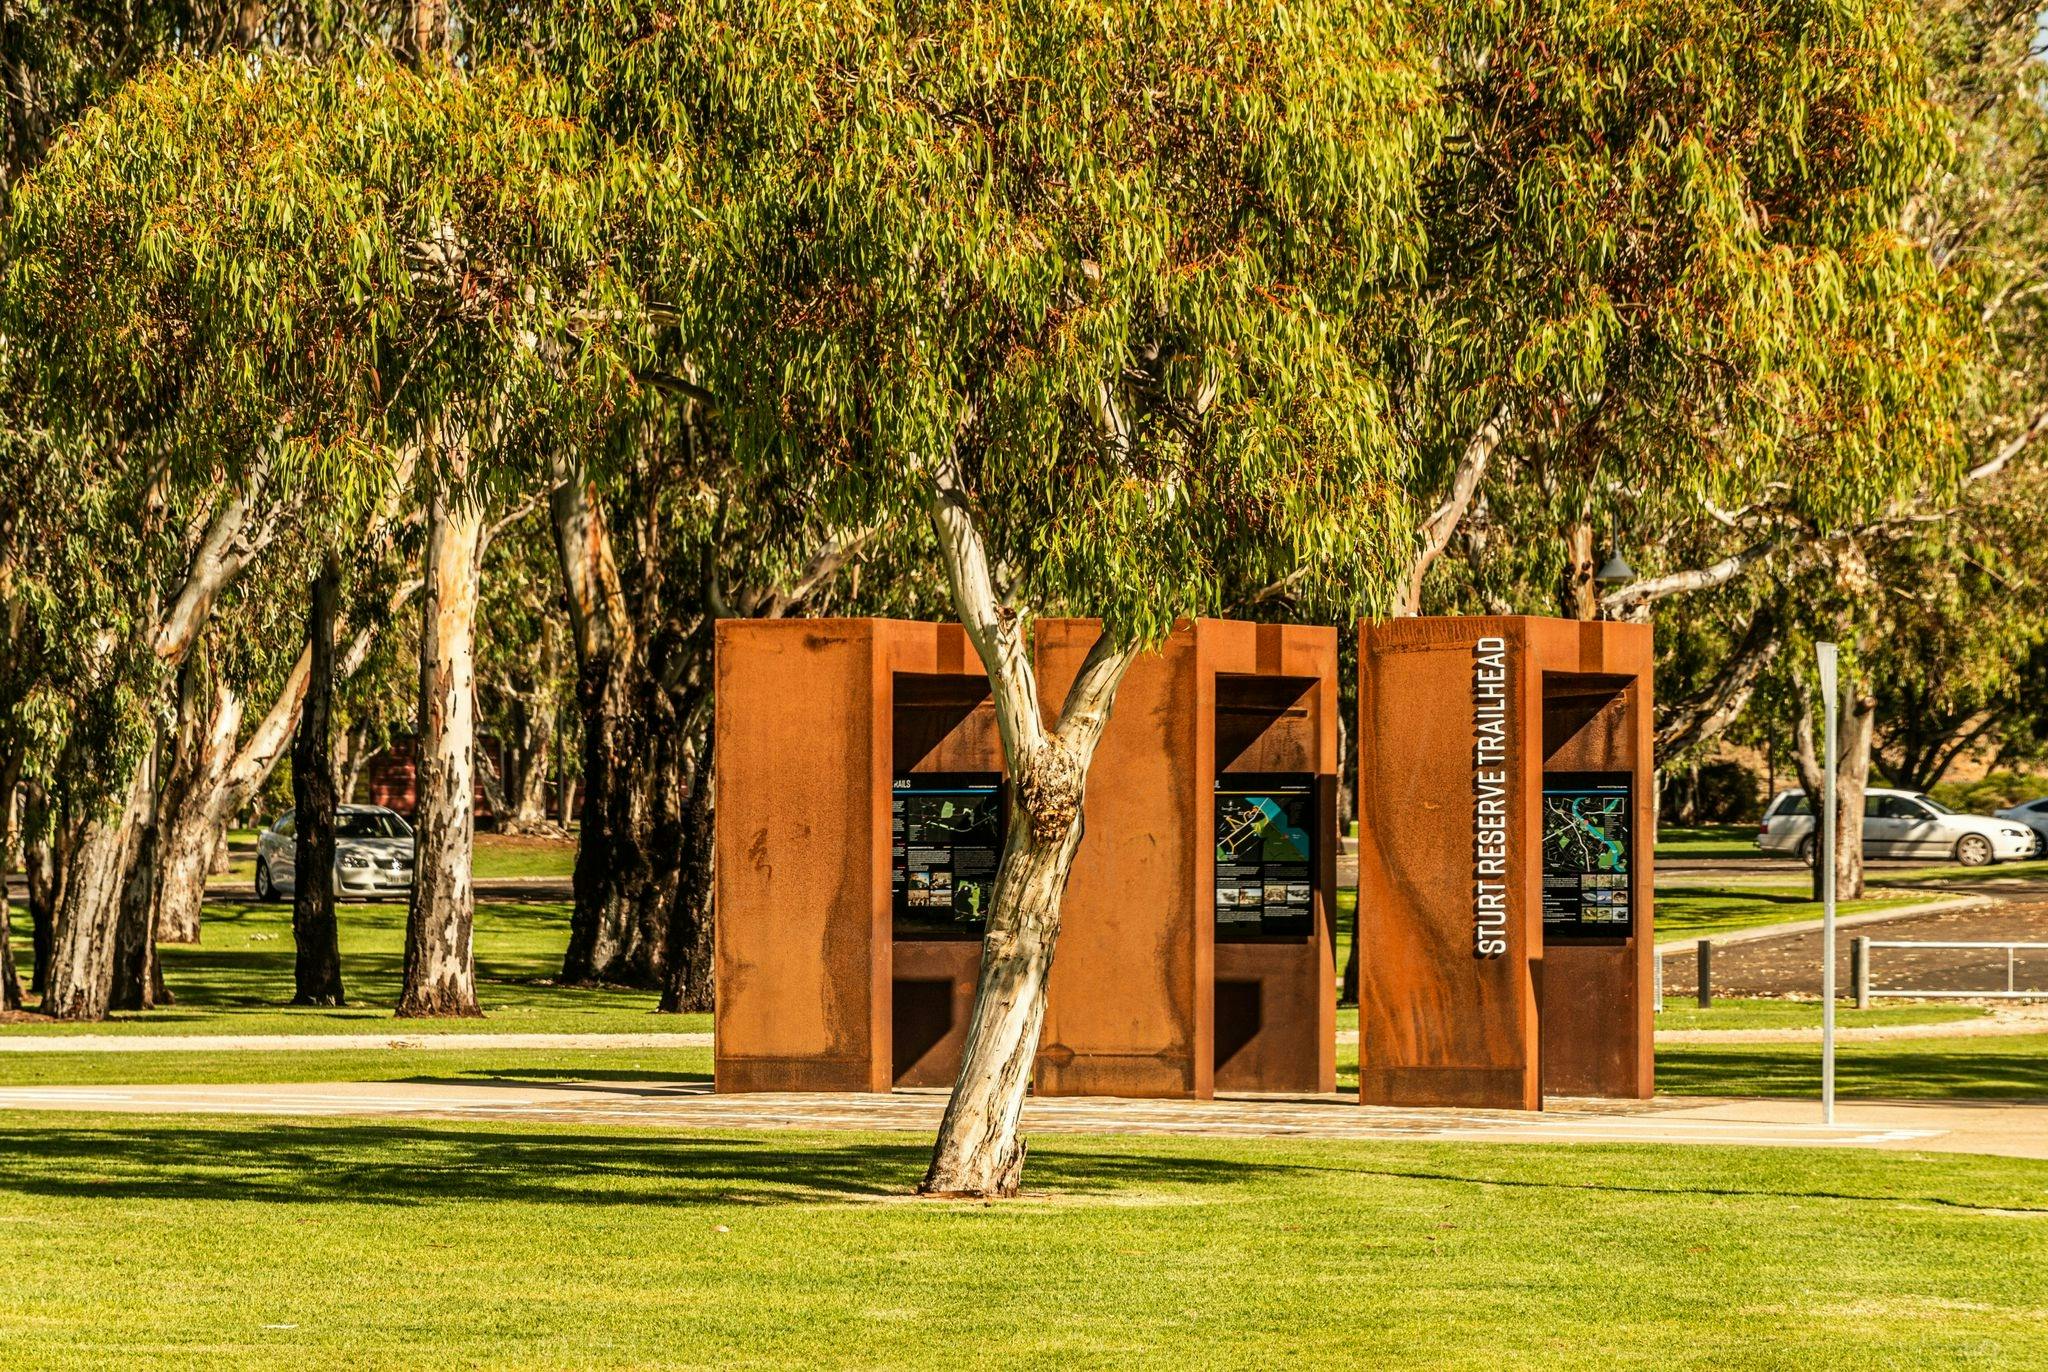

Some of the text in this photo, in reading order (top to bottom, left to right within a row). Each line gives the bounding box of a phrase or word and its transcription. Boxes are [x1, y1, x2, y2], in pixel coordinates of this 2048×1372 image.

[1478, 637, 1507, 954] STURT RESERVE TRAILHEAD
